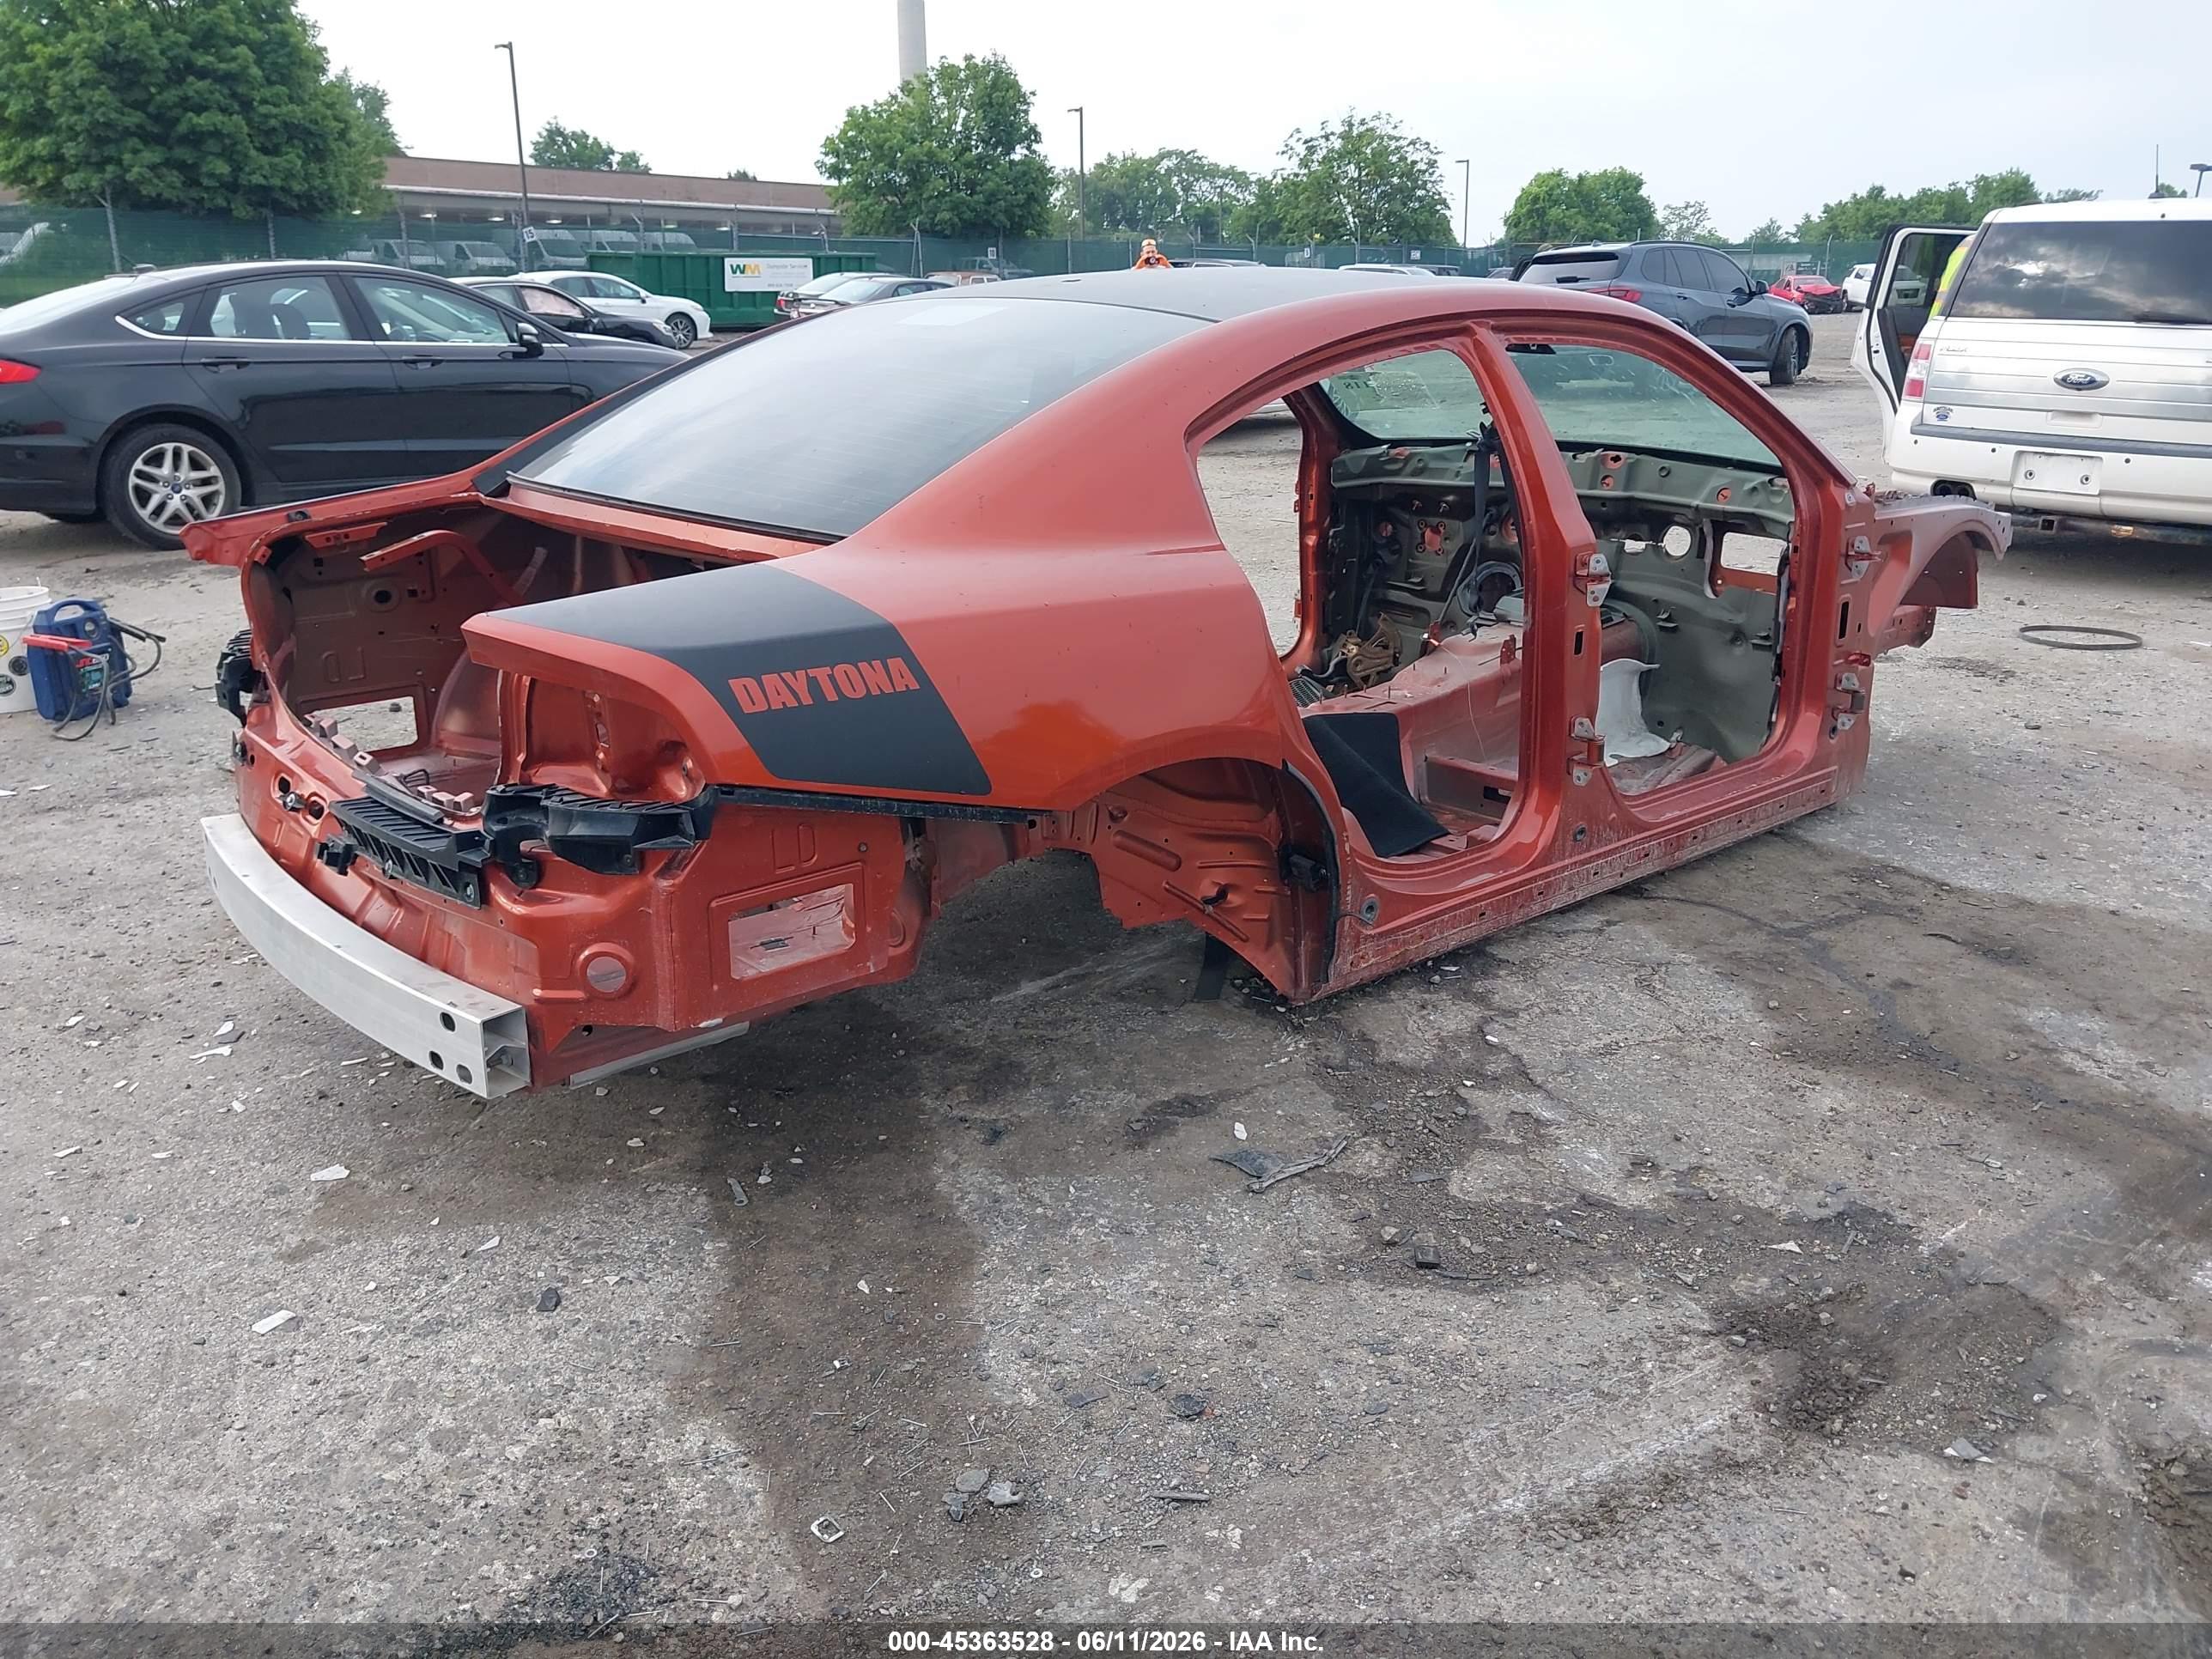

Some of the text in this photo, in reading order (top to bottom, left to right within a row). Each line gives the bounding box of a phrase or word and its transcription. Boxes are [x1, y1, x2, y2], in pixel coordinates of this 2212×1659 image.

[525, 228, 535, 240] 15
[730, 264, 762, 275] WM
[728, 657, 921, 714] DAYTONA
